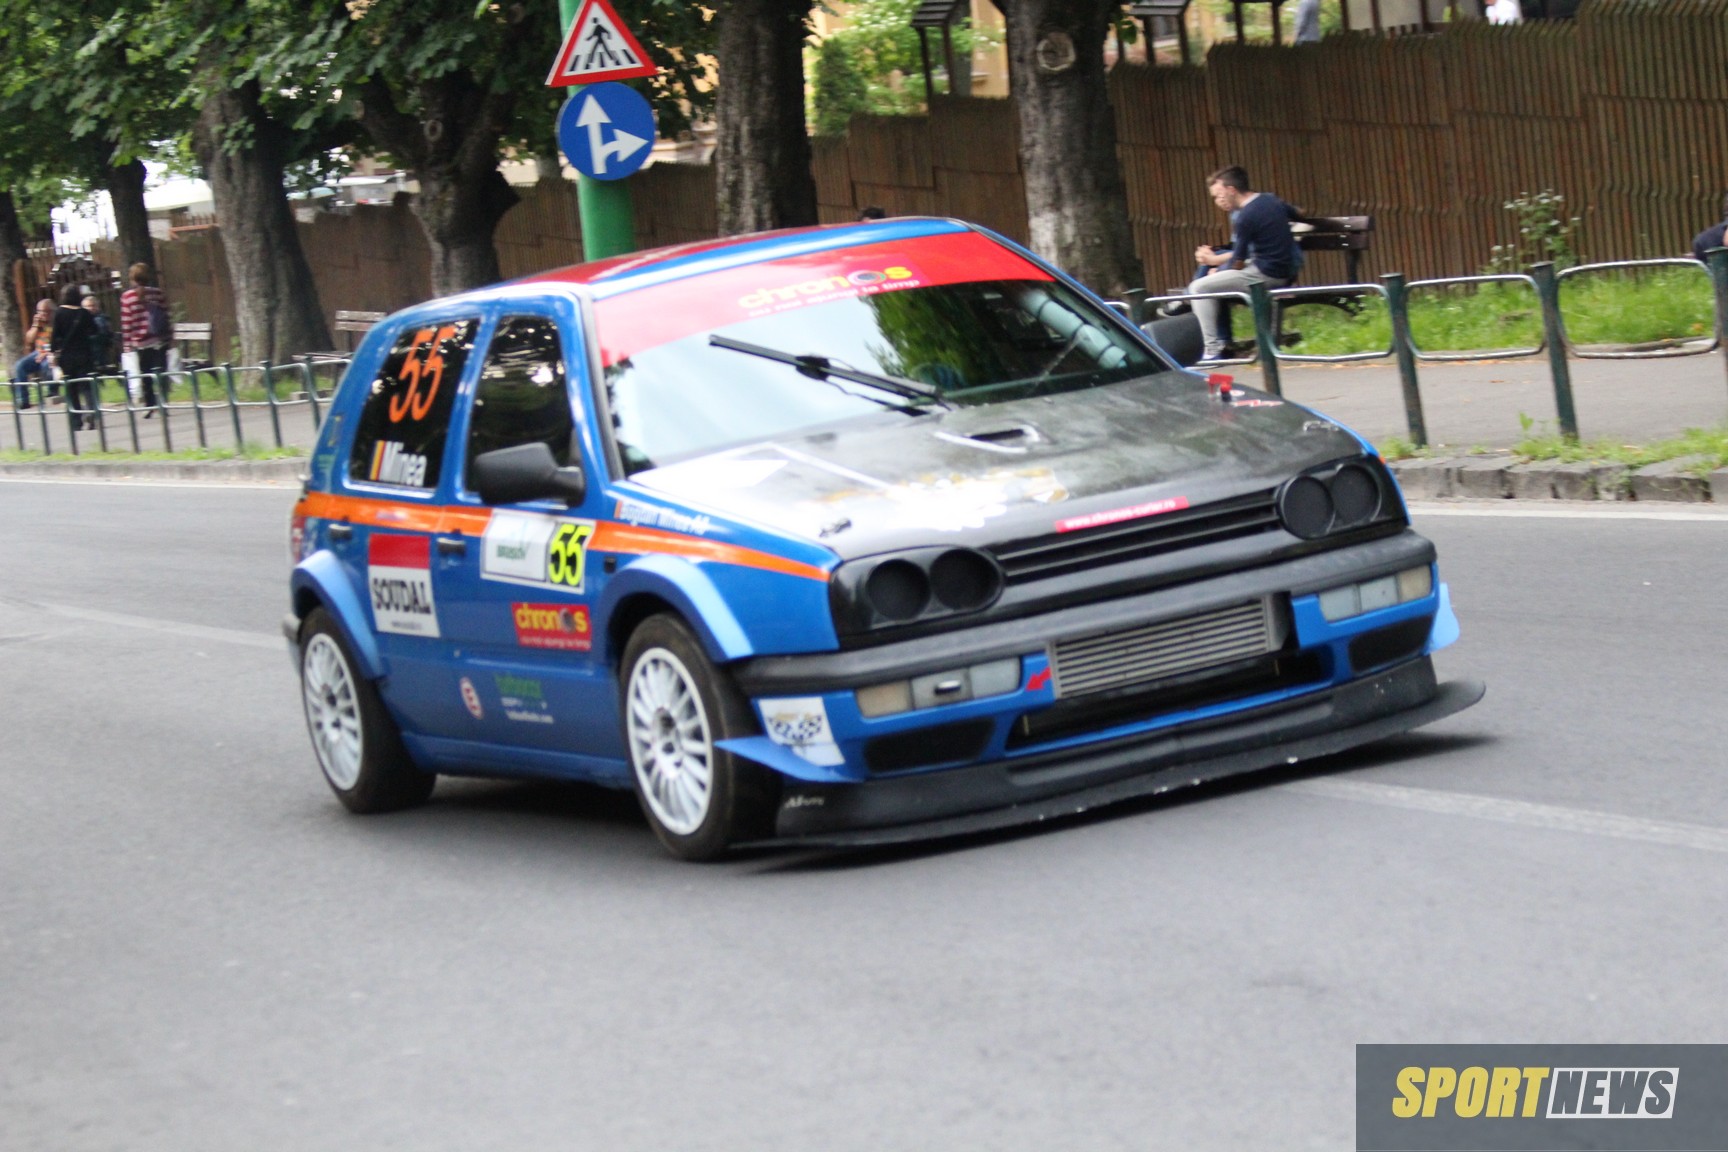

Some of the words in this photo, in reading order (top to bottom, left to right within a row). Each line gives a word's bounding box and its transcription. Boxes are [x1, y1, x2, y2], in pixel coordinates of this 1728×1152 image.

[389, 325, 457, 423] 55
[379, 440, 427, 486] Minea
[548, 523, 593, 586] 55
[373, 578, 432, 614] SOUDAL
[515, 602, 588, 633] chronos
